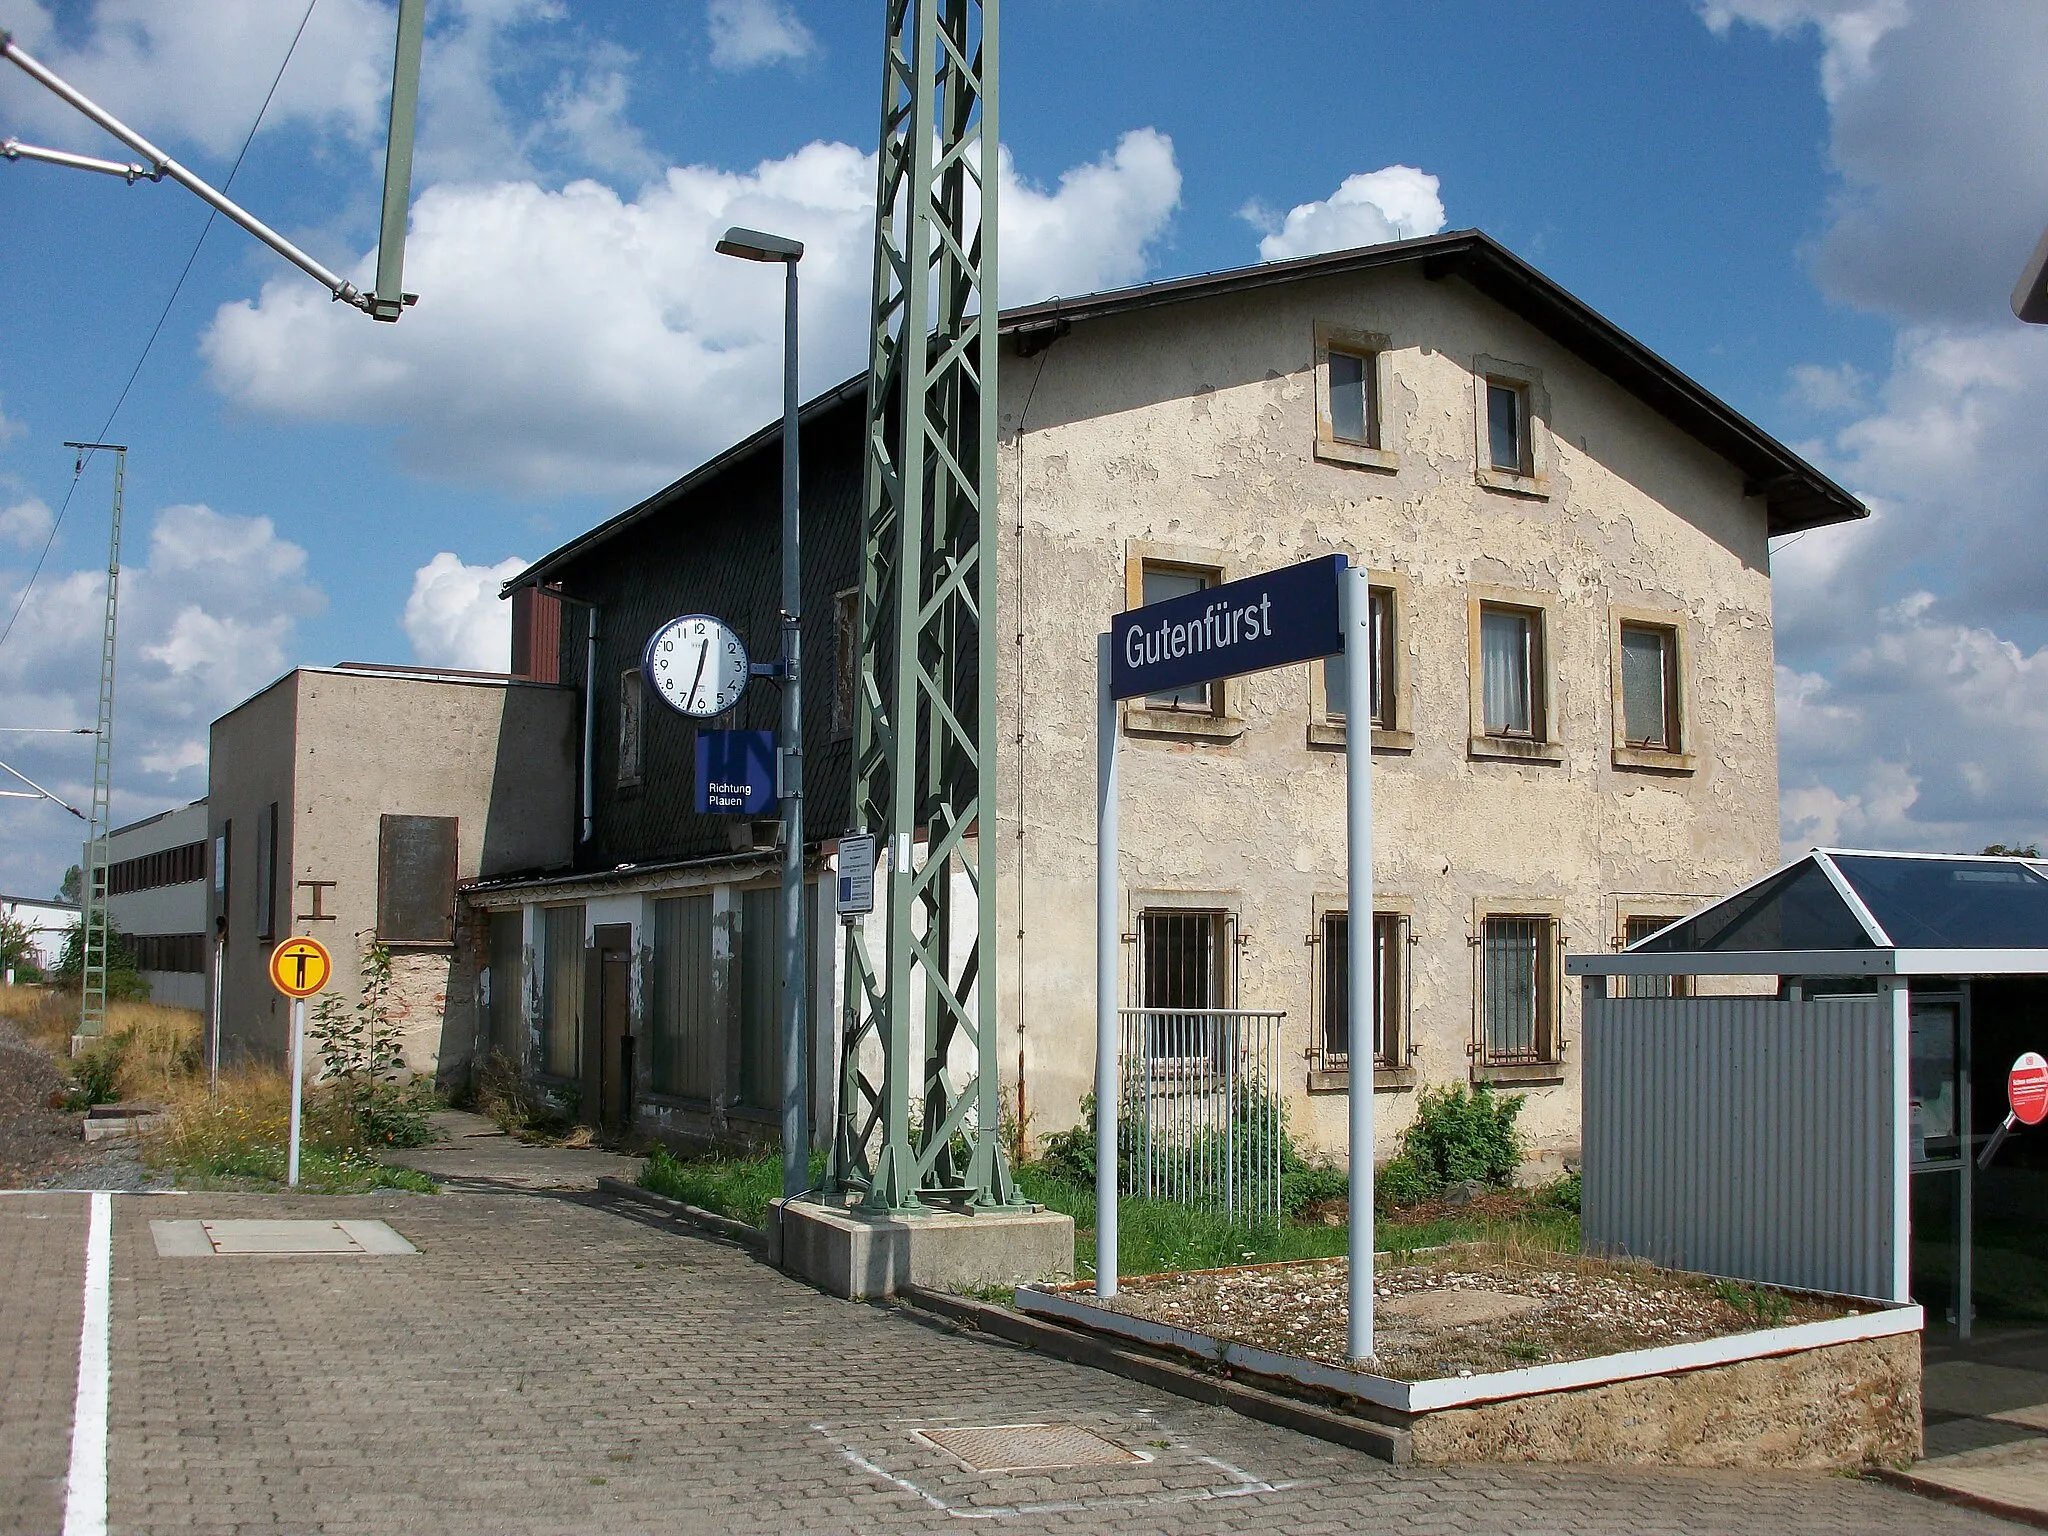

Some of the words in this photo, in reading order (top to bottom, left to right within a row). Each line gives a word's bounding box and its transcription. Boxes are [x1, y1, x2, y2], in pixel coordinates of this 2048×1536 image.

[677, 627, 687, 639] 11
[694, 622, 706, 635] 12
[1125, 592, 1272, 668] Gutenfürst
[662, 640, 674, 652] 10
[727, 642, 737, 654] 2
[659, 659, 669, 671] 9
[734, 660, 743, 672] 3
[665, 678, 674, 690] 8
[727, 679, 737, 691] 4
[679, 691, 687, 704] 7
[697, 697, 706, 709] 6
[716, 692, 725, 704] 5
[709, 782, 752, 796] Richtung
[709, 795, 742, 806] Plauen
